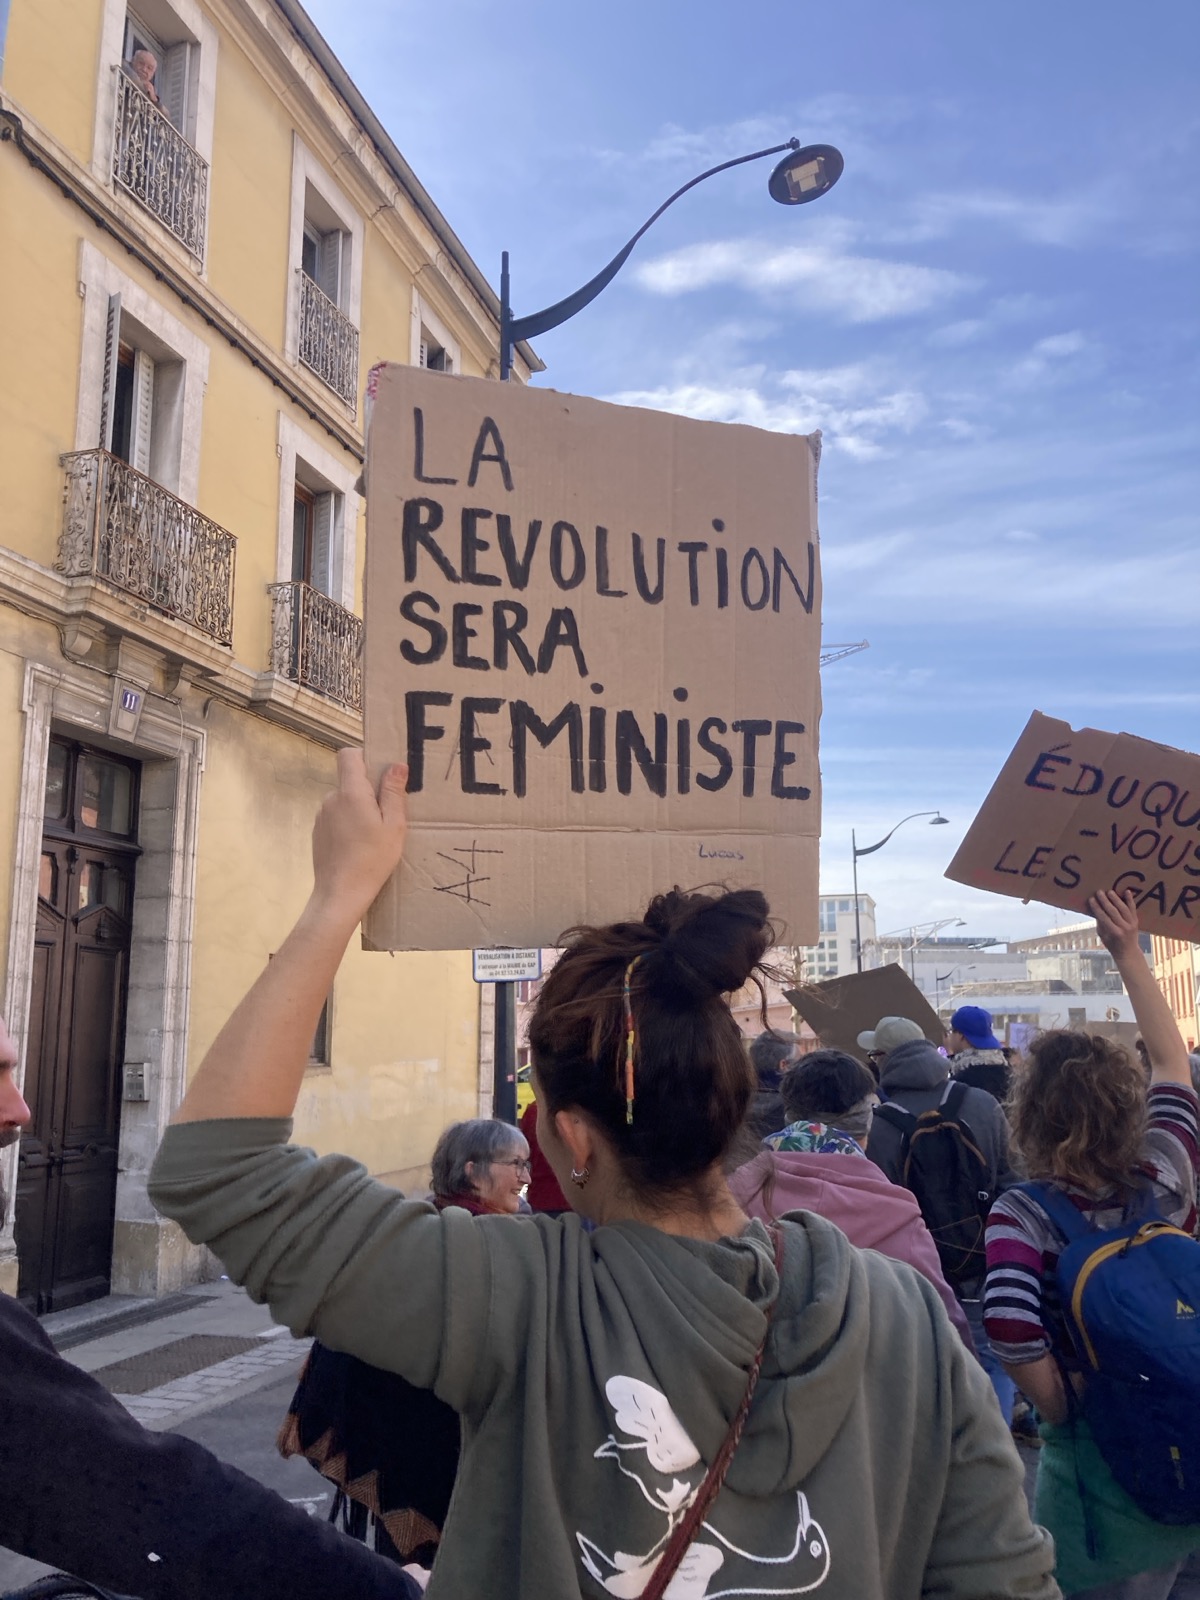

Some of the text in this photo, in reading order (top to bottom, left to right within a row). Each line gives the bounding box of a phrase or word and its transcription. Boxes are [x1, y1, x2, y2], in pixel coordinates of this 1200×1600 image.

[413, 406, 514, 492] LA
[399, 590, 588, 678] SERA
[125, 693, 136, 710] 11
[1024, 741, 1200, 831] ÉDUQU
[698, 844, 745, 860] Lucas
[993, 840, 1082, 890] LES
